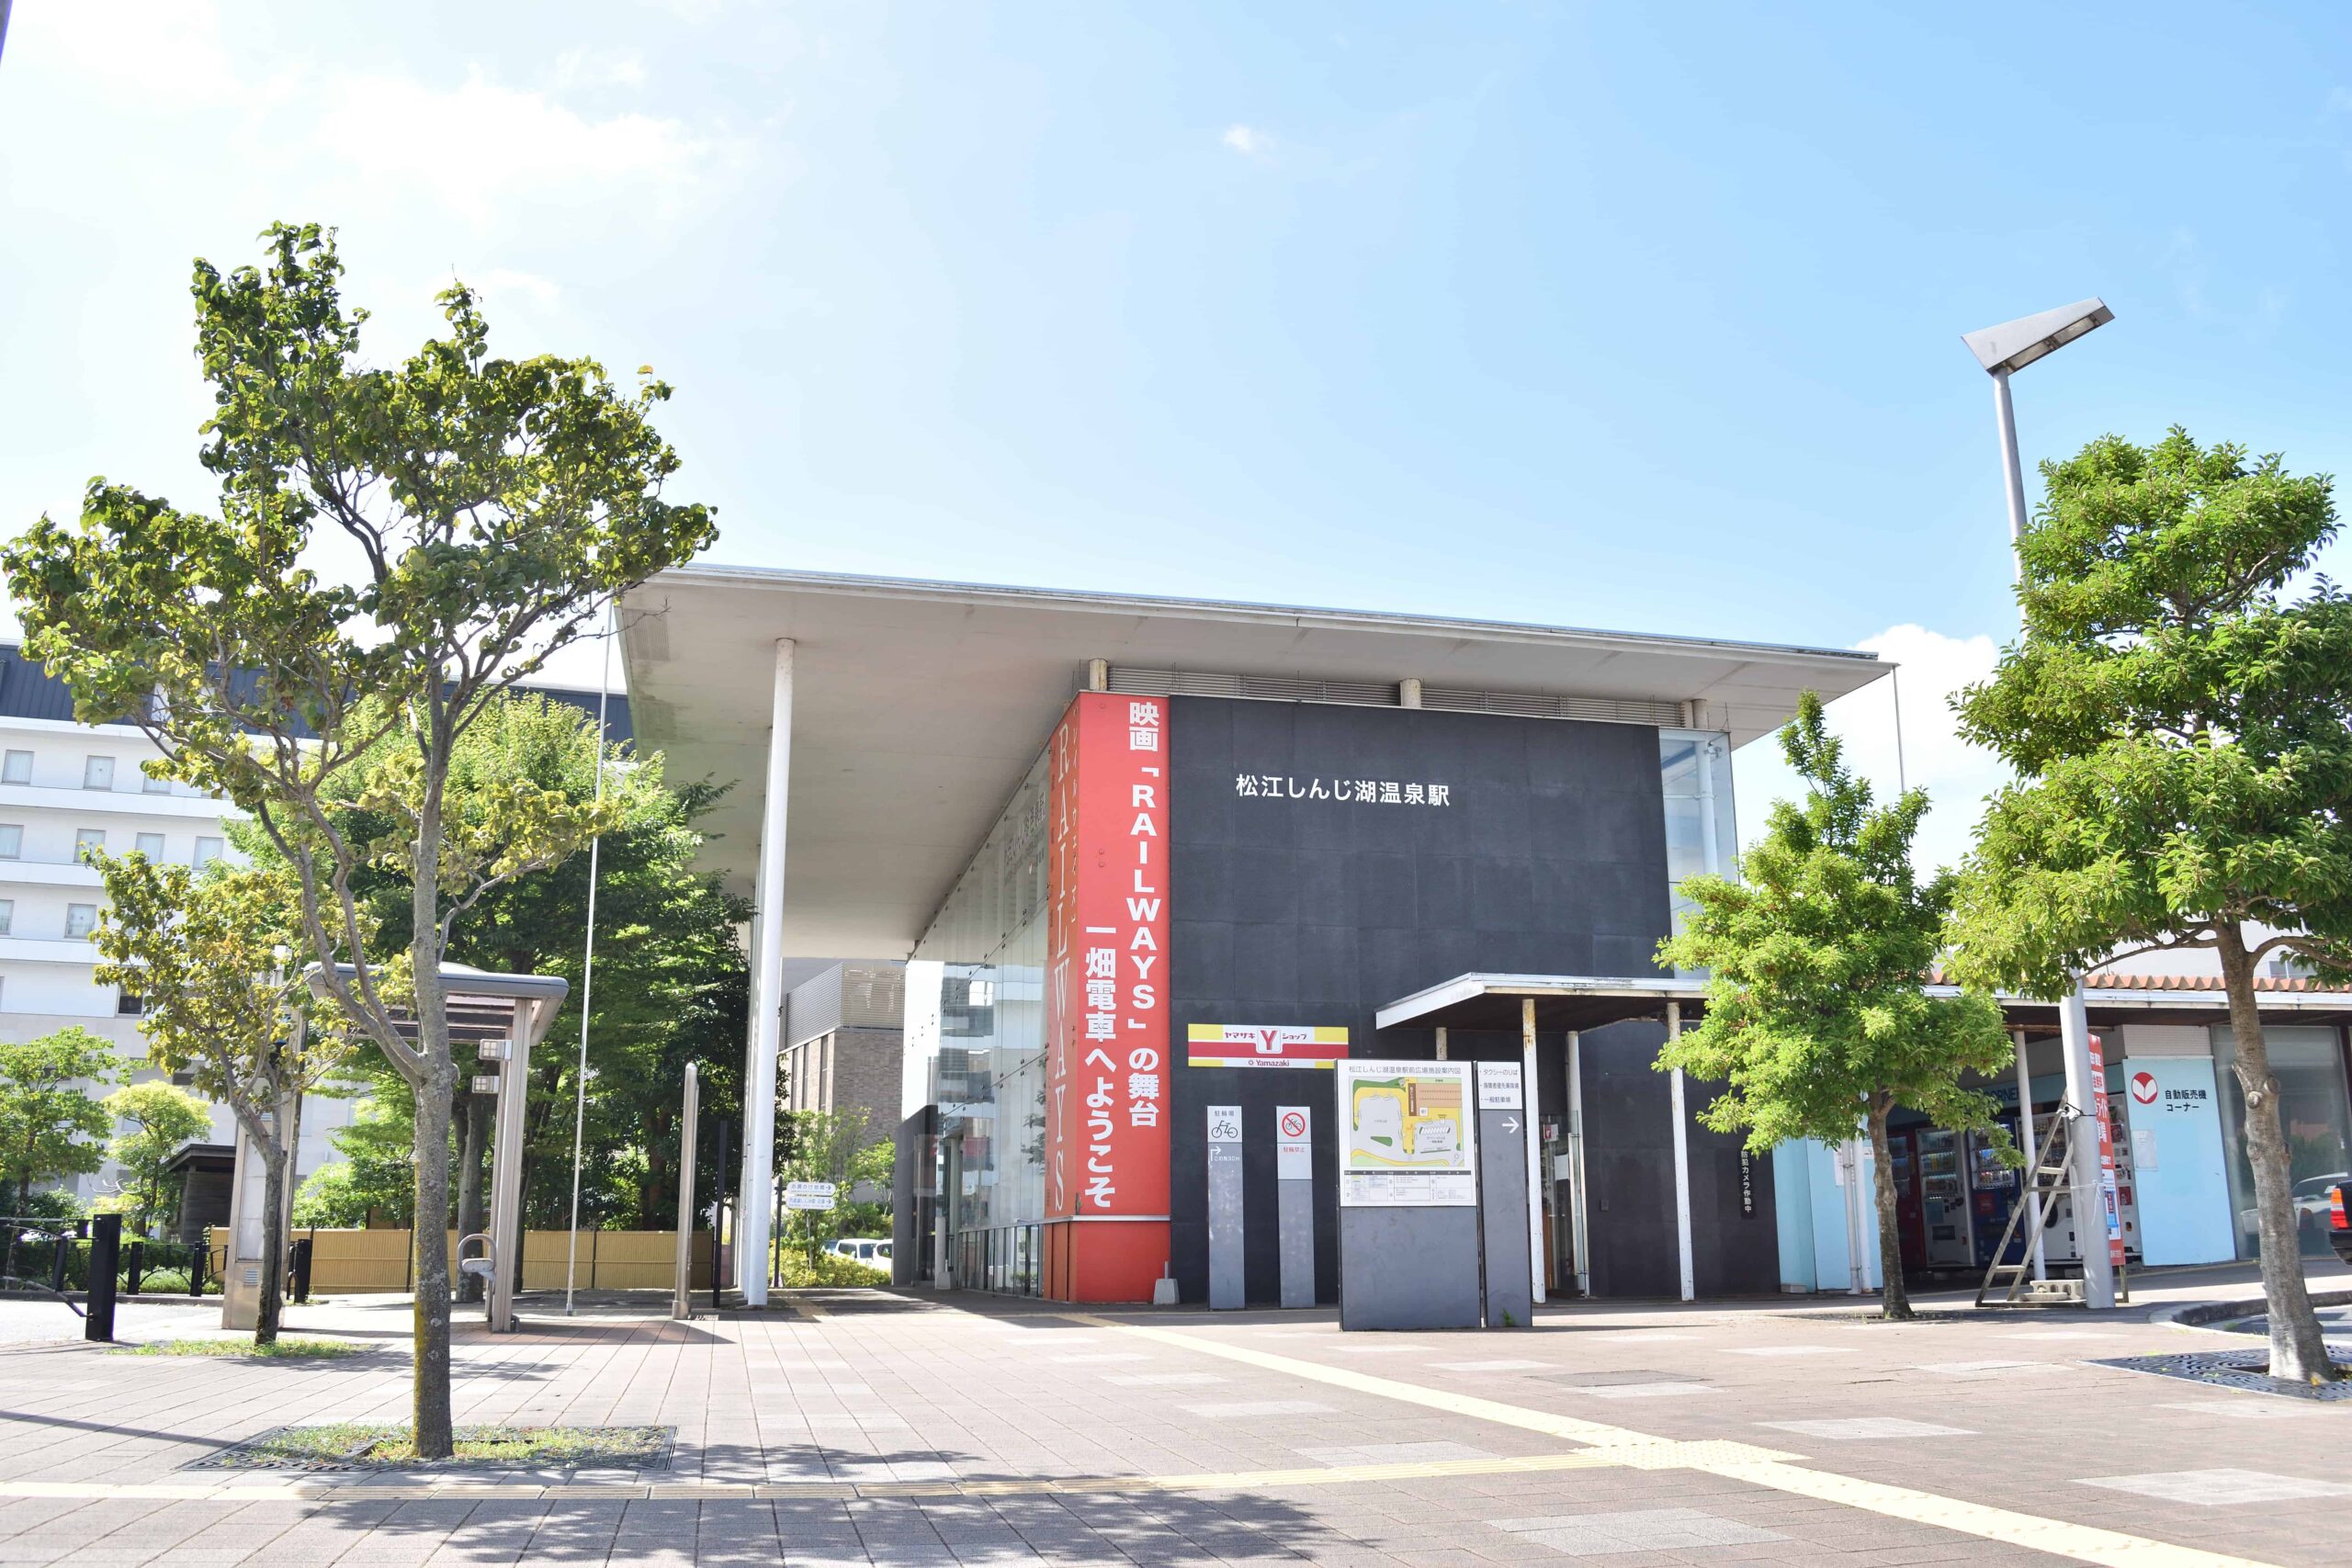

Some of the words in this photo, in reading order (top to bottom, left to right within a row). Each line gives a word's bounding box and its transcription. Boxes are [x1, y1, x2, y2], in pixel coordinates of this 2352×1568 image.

[1235, 773, 1451, 807] 松江しんじ湖温泉駅
[1054, 722, 1070, 1212] RAILWAYS
[1225, 1032, 1256, 1040] ヤマザキ
[1260, 1029, 1278, 1051] Y
[1282, 1032, 1307, 1041] ショップ
[1084, 926, 1117, 1209] 一畑電車へようこそ
[1256, 1059, 1290, 1067] Yamazaki
[2165, 1089, 2207, 1100] 自動販売機
[2165, 1102, 2200, 1112] コーナー
